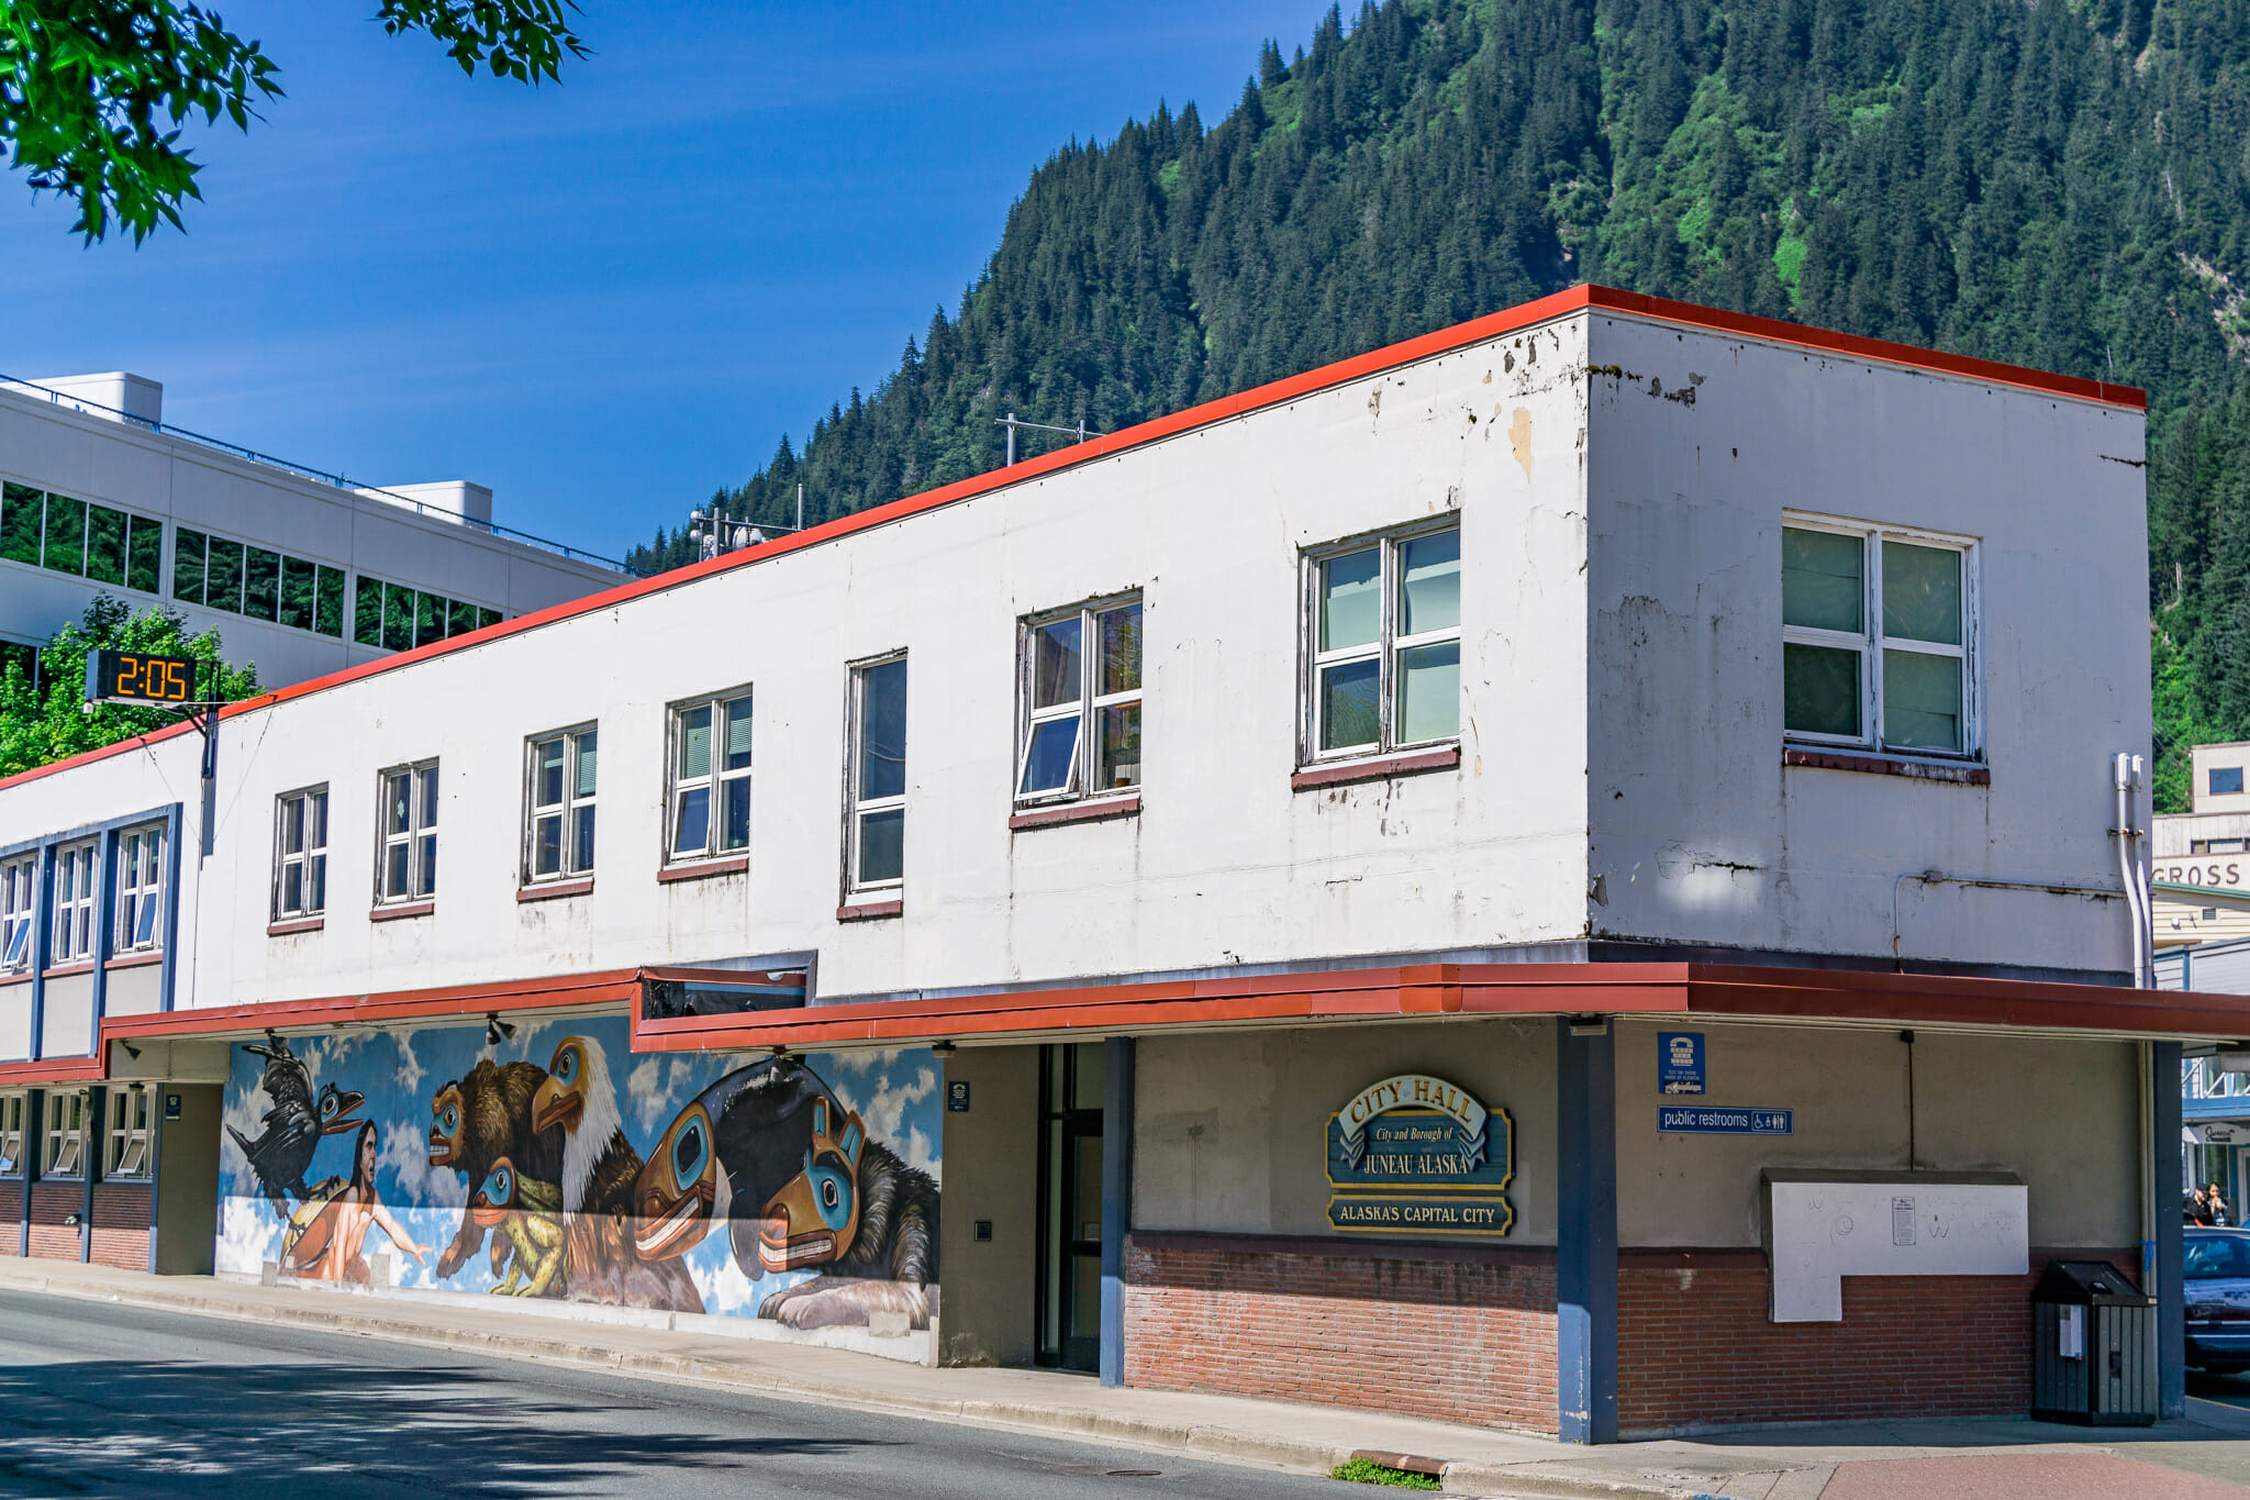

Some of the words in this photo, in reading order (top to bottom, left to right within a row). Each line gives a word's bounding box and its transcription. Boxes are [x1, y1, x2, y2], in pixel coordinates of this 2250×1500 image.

[117, 657, 186, 699] 2:05
[2152, 864, 2240, 886] GROSS
[1350, 1080, 1404, 1124] CITY
[1414, 1079, 1473, 1123] HALL
[1664, 1110, 1696, 1128] public
[1698, 1111, 1748, 1127] restrooms
[1376, 1127, 1392, 1142] City
[1394, 1127, 1409, 1140] and
[1411, 1127, 1441, 1142] Borough
[1443, 1127, 1453, 1140] of
[1363, 1154, 1413, 1174] JUNEAU
[1417, 1154, 1468, 1174] ALASKA
[1340, 1206, 1400, 1221] ALASKA'S
[1404, 1207, 1458, 1222] CAPITAL
[1462, 1208, 1495, 1222] CITY
